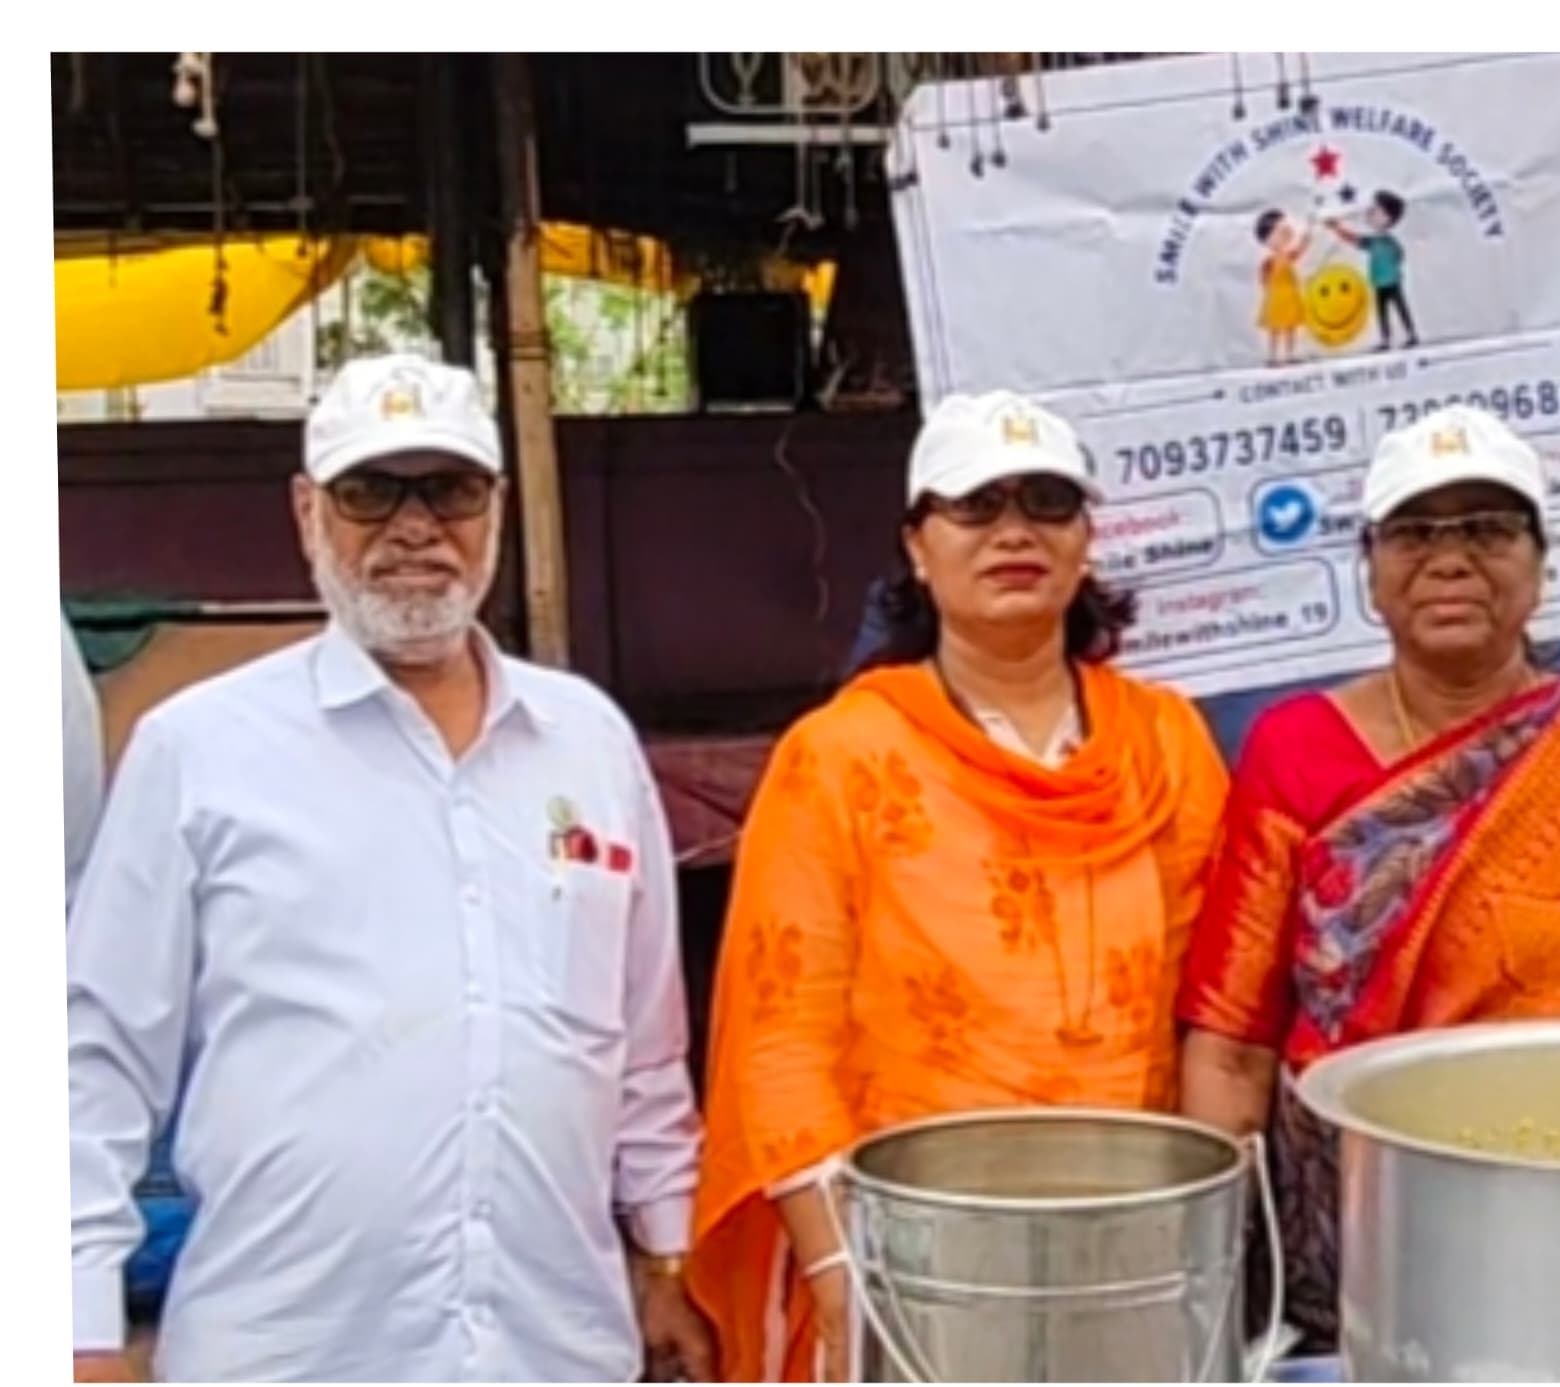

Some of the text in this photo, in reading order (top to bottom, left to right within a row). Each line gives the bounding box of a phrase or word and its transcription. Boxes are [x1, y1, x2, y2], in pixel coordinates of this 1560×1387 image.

[1156, 105, 1504, 284] SMILE WITH SHINE WELFARE SOCIETY
[1239, 361, 1406, 402] CONTACT WITH US
[1115, 415, 1347, 484] 7093737459
